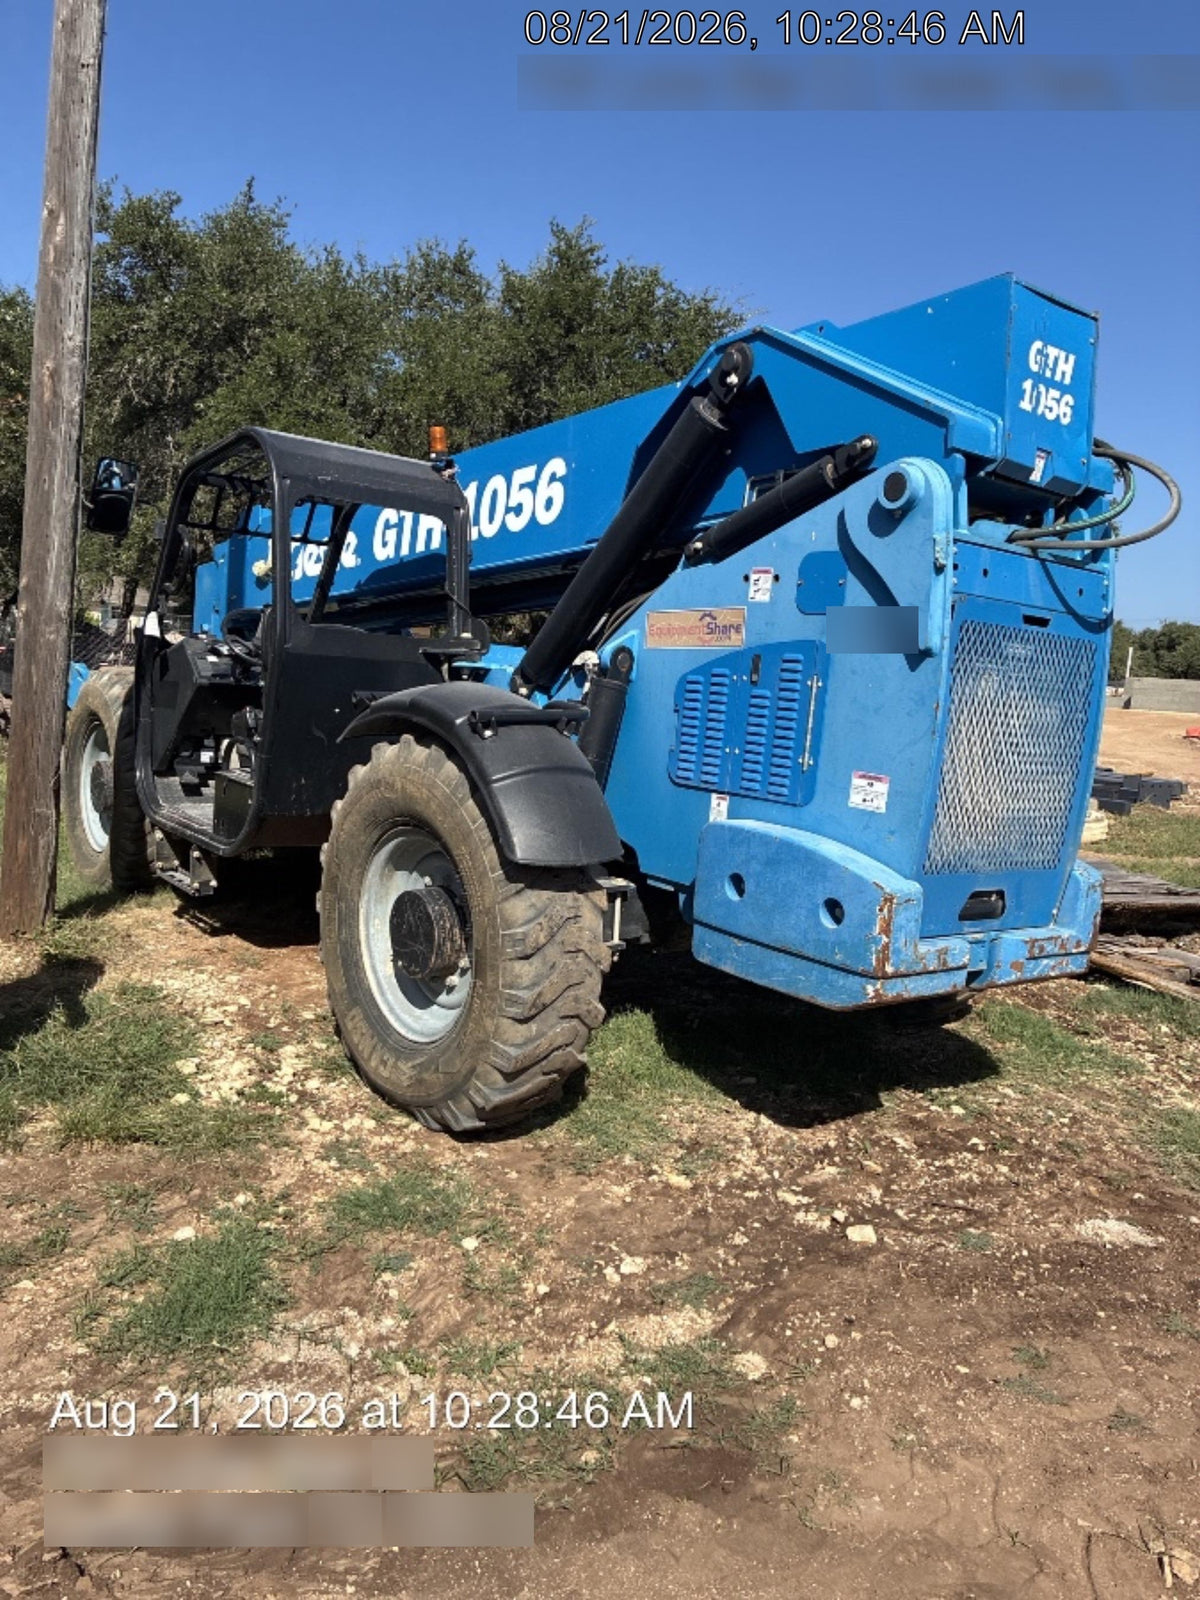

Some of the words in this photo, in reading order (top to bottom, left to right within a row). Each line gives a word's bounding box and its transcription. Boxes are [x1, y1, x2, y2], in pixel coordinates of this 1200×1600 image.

[1028, 340, 1076, 386] GTH
[1019, 378, 1075, 426] 1056
[463, 457, 567, 541] 1056
